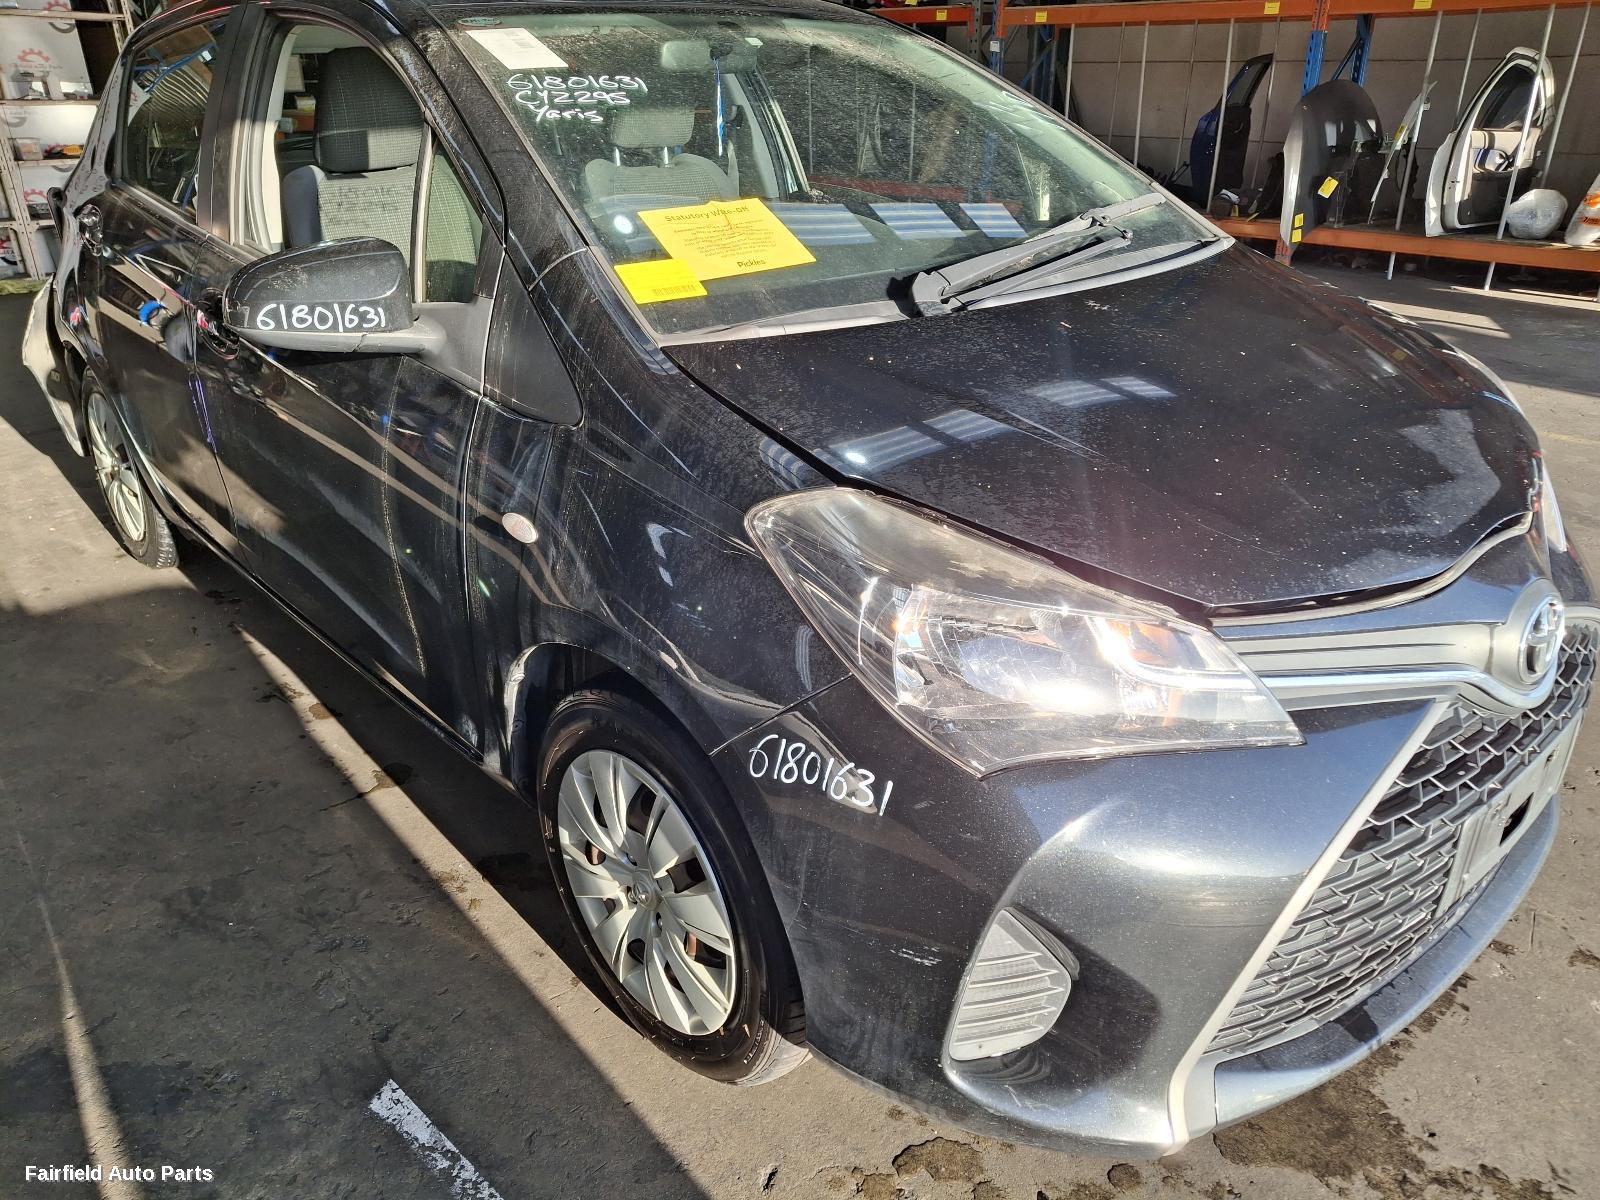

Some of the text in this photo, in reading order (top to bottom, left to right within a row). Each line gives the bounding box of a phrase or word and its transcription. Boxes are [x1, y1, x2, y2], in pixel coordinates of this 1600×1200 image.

[506, 73, 649, 92] 61801631
[527, 103, 604, 122] Yaris
[664, 210, 710, 222] Statutory
[737, 258, 766, 269] Pickles
[256, 303, 386, 333] 61801631
[748, 734, 894, 817] 61801631
